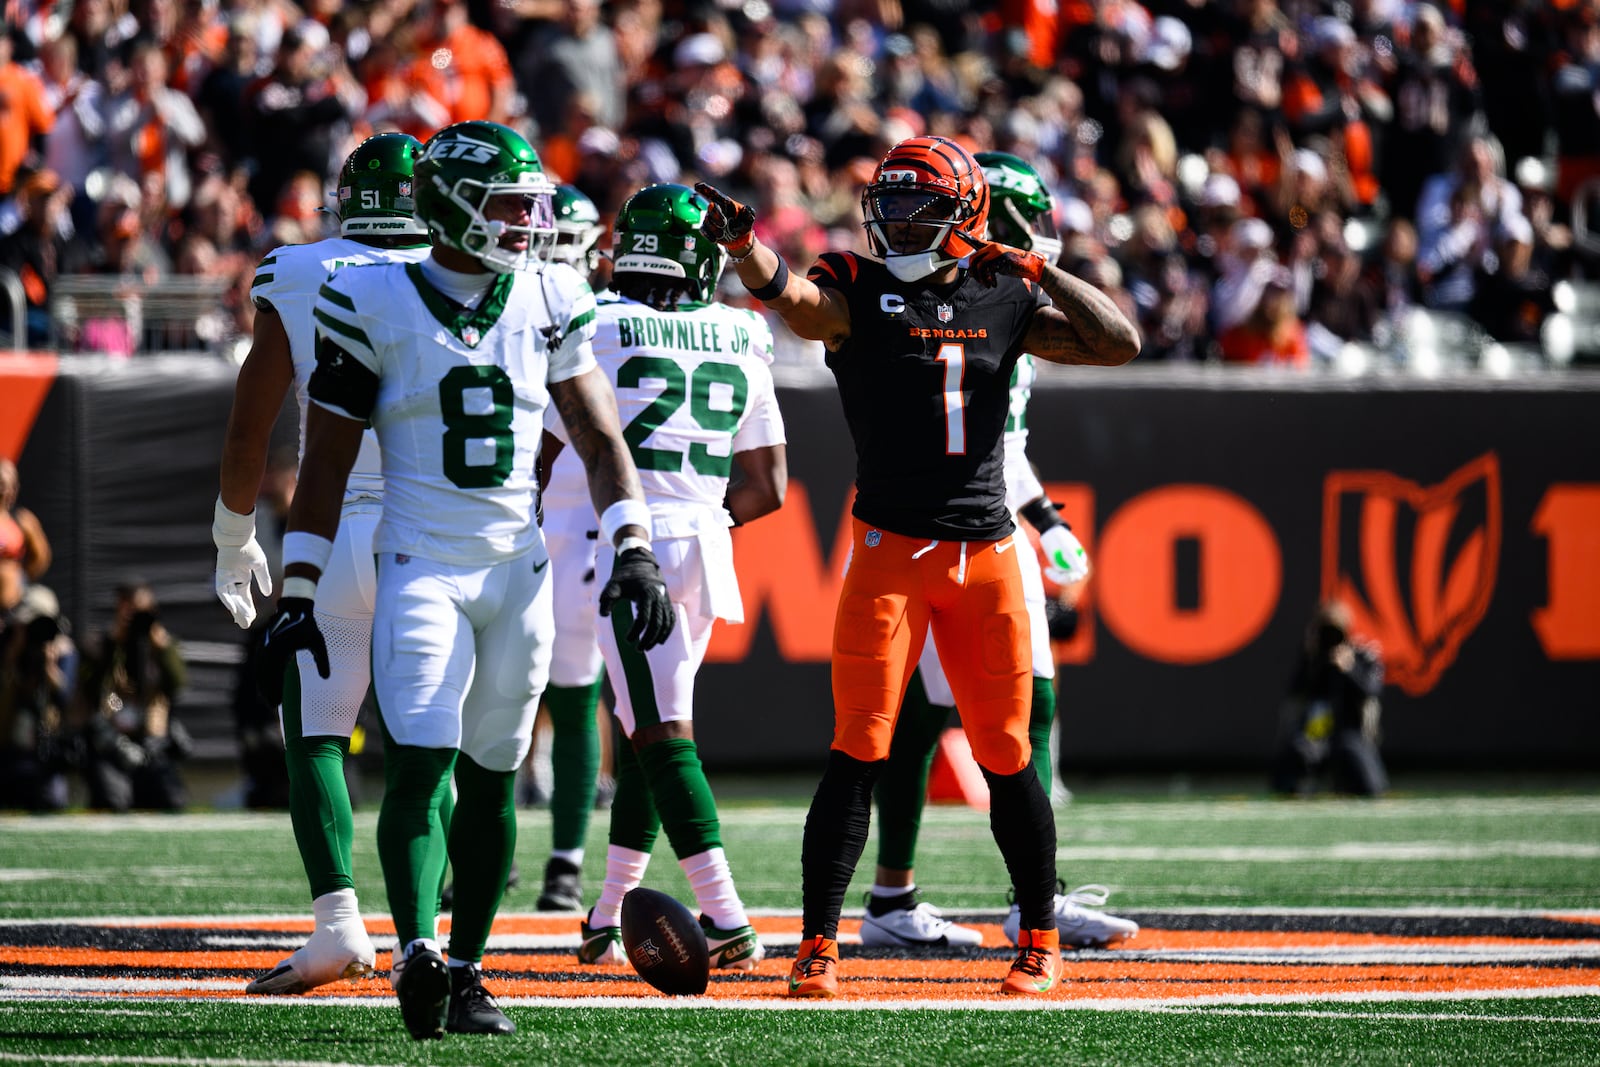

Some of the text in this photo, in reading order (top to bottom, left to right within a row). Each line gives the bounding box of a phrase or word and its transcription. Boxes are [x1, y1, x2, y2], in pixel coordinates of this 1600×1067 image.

[360, 190, 381, 209] 51
[372, 222, 406, 230] YORK
[632, 234, 658, 253] 29
[642, 262, 677, 271] YORK
[880, 294, 905, 313] C
[618, 317, 749, 356] BROWNLEE JR
[909, 327, 988, 339] BENGALS
[935, 342, 967, 456] 1
[617, 356, 748, 478] 29
[439, 365, 514, 489] 8
